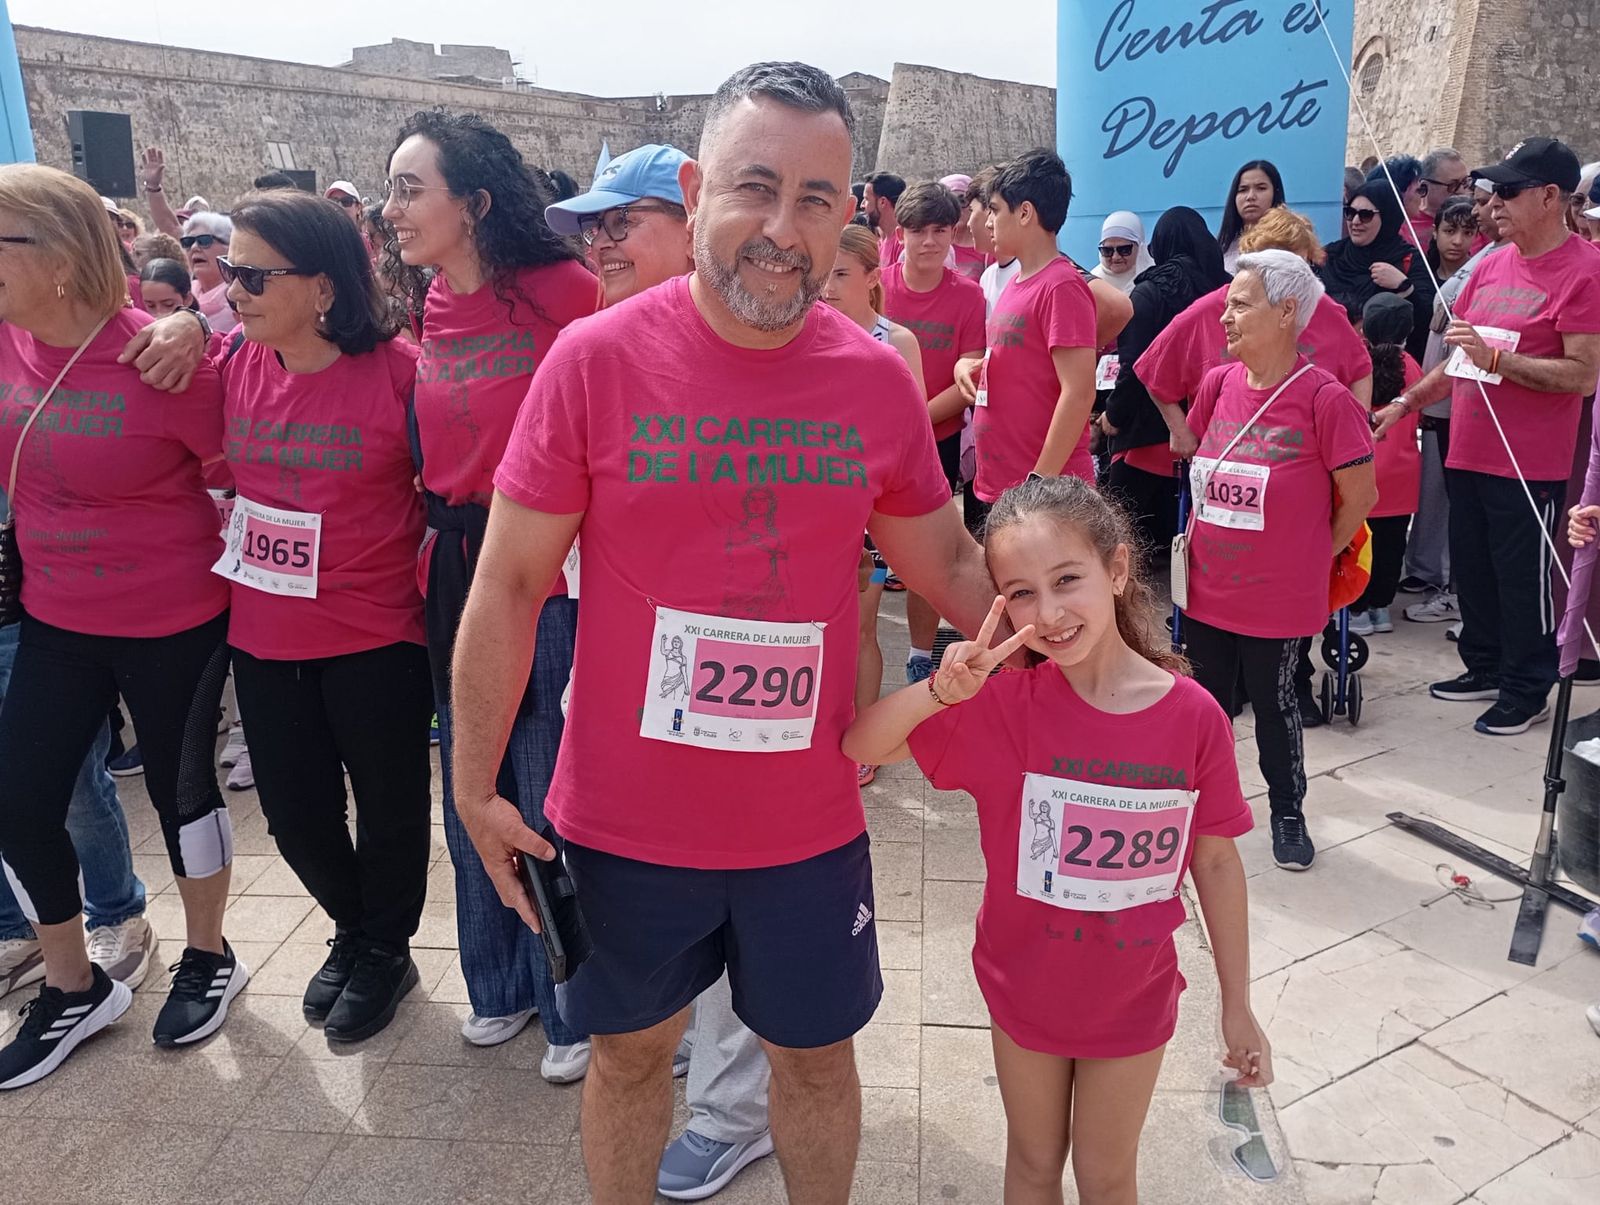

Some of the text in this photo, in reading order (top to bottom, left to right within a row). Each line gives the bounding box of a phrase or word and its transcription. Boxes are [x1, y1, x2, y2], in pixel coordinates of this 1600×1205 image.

[1283, 0, 1329, 34] es
[1101, 79, 1328, 178] Deporte
[254, 419, 363, 447] CARRERA
[631, 413, 866, 454] XXI CARRERA
[279, 447, 363, 472] MUJER
[628, 451, 680, 483] DE
[749, 453, 868, 488] MUJER
[1207, 481, 1259, 508] 1032
[282, 518, 306, 527] MUJER
[244, 530, 310, 569] 1965
[684, 624, 811, 645] XXI CARRERA DE LA MUJER
[695, 661, 814, 708] 2290
[1052, 756, 1187, 785] XXI CARRERA
[1051, 789, 1179, 810] XXI CARRERA DE LA MUJER
[1064, 825, 1180, 869] 2289
